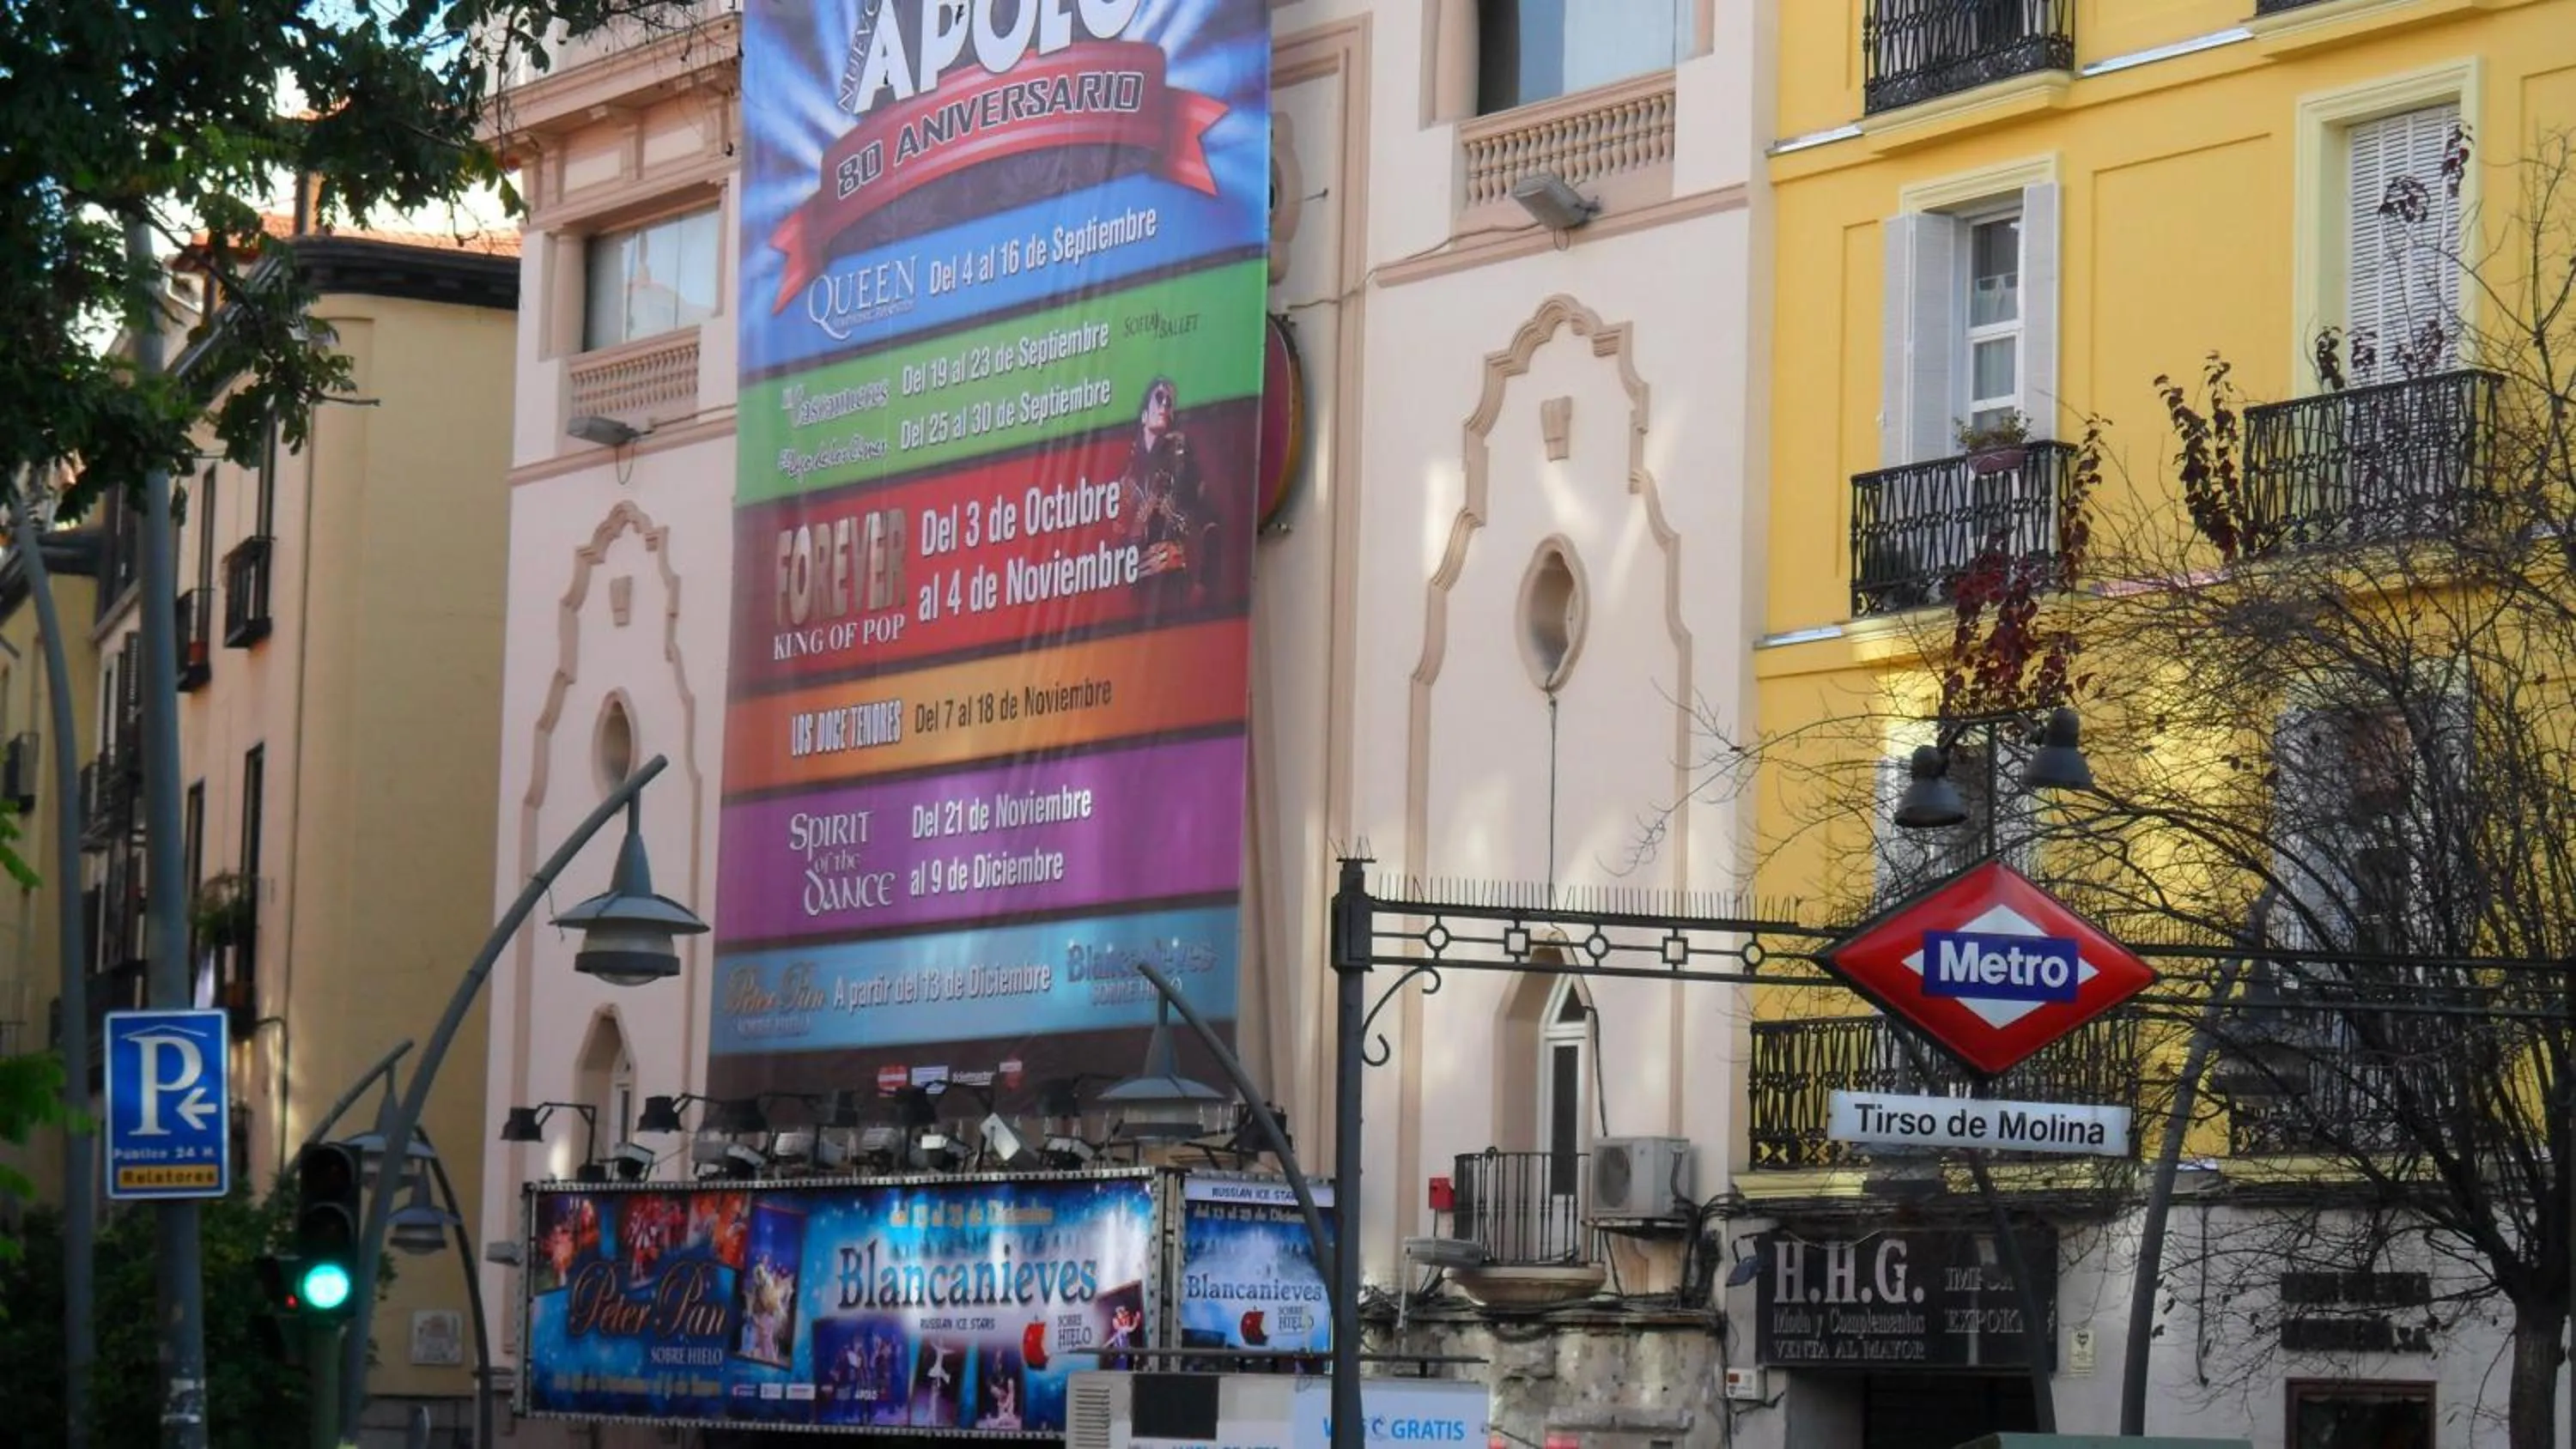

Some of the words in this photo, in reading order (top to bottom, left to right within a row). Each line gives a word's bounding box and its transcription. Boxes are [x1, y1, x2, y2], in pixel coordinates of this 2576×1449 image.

[837, 140, 883, 199] 80
[894, 71, 1144, 166] ANIVERSARIO
[929, 256, 957, 296] Del
[963, 259, 974, 286] 4
[979, 252, 994, 283] al
[1001, 243, 1019, 276] 16
[1024, 237, 1047, 270] de
[1053, 208, 1158, 263] Septiembre
[808, 254, 917, 339] QUEEN
[902, 362, 926, 397] Del
[930, 356, 947, 388] 19
[952, 353, 968, 384] al
[970, 347, 991, 380] 23
[996, 342, 1014, 373] de
[1018, 320, 1109, 368] Septiembre
[901, 416, 924, 452] Del
[929, 411, 948, 442] 25
[951, 408, 967, 439] al
[970, 403, 992, 433] 30
[997, 397, 1016, 427] de
[1019, 378, 1111, 423] Septiembre
[922, 507, 957, 556] Del
[966, 500, 981, 548] 3
[987, 494, 1016, 541] de
[1024, 477, 1121, 536] Octubre
[778, 510, 907, 624] FOREVER
[920, 573, 940, 622] al
[947, 570, 963, 617] 4
[969, 565, 997, 613] de
[1006, 542, 1139, 604] Noviembre
[775, 624, 823, 660] KING
[829, 621, 857, 652] OF
[862, 614, 905, 645] POP
[791, 712, 814, 757] LOS
[817, 707, 848, 753] DOCE
[851, 700, 902, 749] TENORES
[914, 700, 939, 733] Del
[945, 699, 954, 726] 7
[957, 695, 973, 727] al
[976, 691, 994, 724] 18
[999, 688, 1018, 721] de
[1024, 678, 1113, 718] Noviembre
[913, 803, 939, 839] Del
[945, 800, 964, 835] 21
[969, 796, 990, 831] de
[995, 786, 1093, 828] Noviembre
[814, 852, 834, 874] of
[835, 848, 862, 873] the
[910, 865, 927, 896] al
[931, 863, 943, 894] 9
[947, 856, 969, 891] de
[975, 849, 1064, 888] Diciembre
[833, 975, 845, 1009] A
[848, 970, 891, 1012] partir
[895, 970, 919, 1001] del
[923, 968, 940, 999] 13
[945, 966, 964, 997] de
[969, 961, 1051, 996] Diciembre
[1940, 940, 2069, 988] Metro
[128, 1036, 203, 1136] P
[1854, 1103, 1936, 1136] Tirso
[1947, 1109, 1986, 1138] de
[1998, 1111, 2105, 1144] Molina
[1274, 1191, 1295, 1200] STA
[570, 1261, 651, 1337] Peter
[651, 1259, 727, 1337] Pan
[838, 1239, 1098, 1310] Blancanieves
[1187, 1274, 1321, 1301] Blancanieves
[1773, 1238, 1924, 1304] H.H.G.
[1058, 1327, 1091, 1350] HIELO
[1830, 1307, 1924, 1339] Complementos
[651, 1347, 686, 1364] SOBRE
[688, 1347, 722, 1365] HIELO
[1774, 1341, 1829, 1359] VENTA
[1835, 1341, 1857, 1359] AL
[1863, 1341, 1924, 1360] MAYOR
[1391, 1419, 1465, 1440] GRATIS
